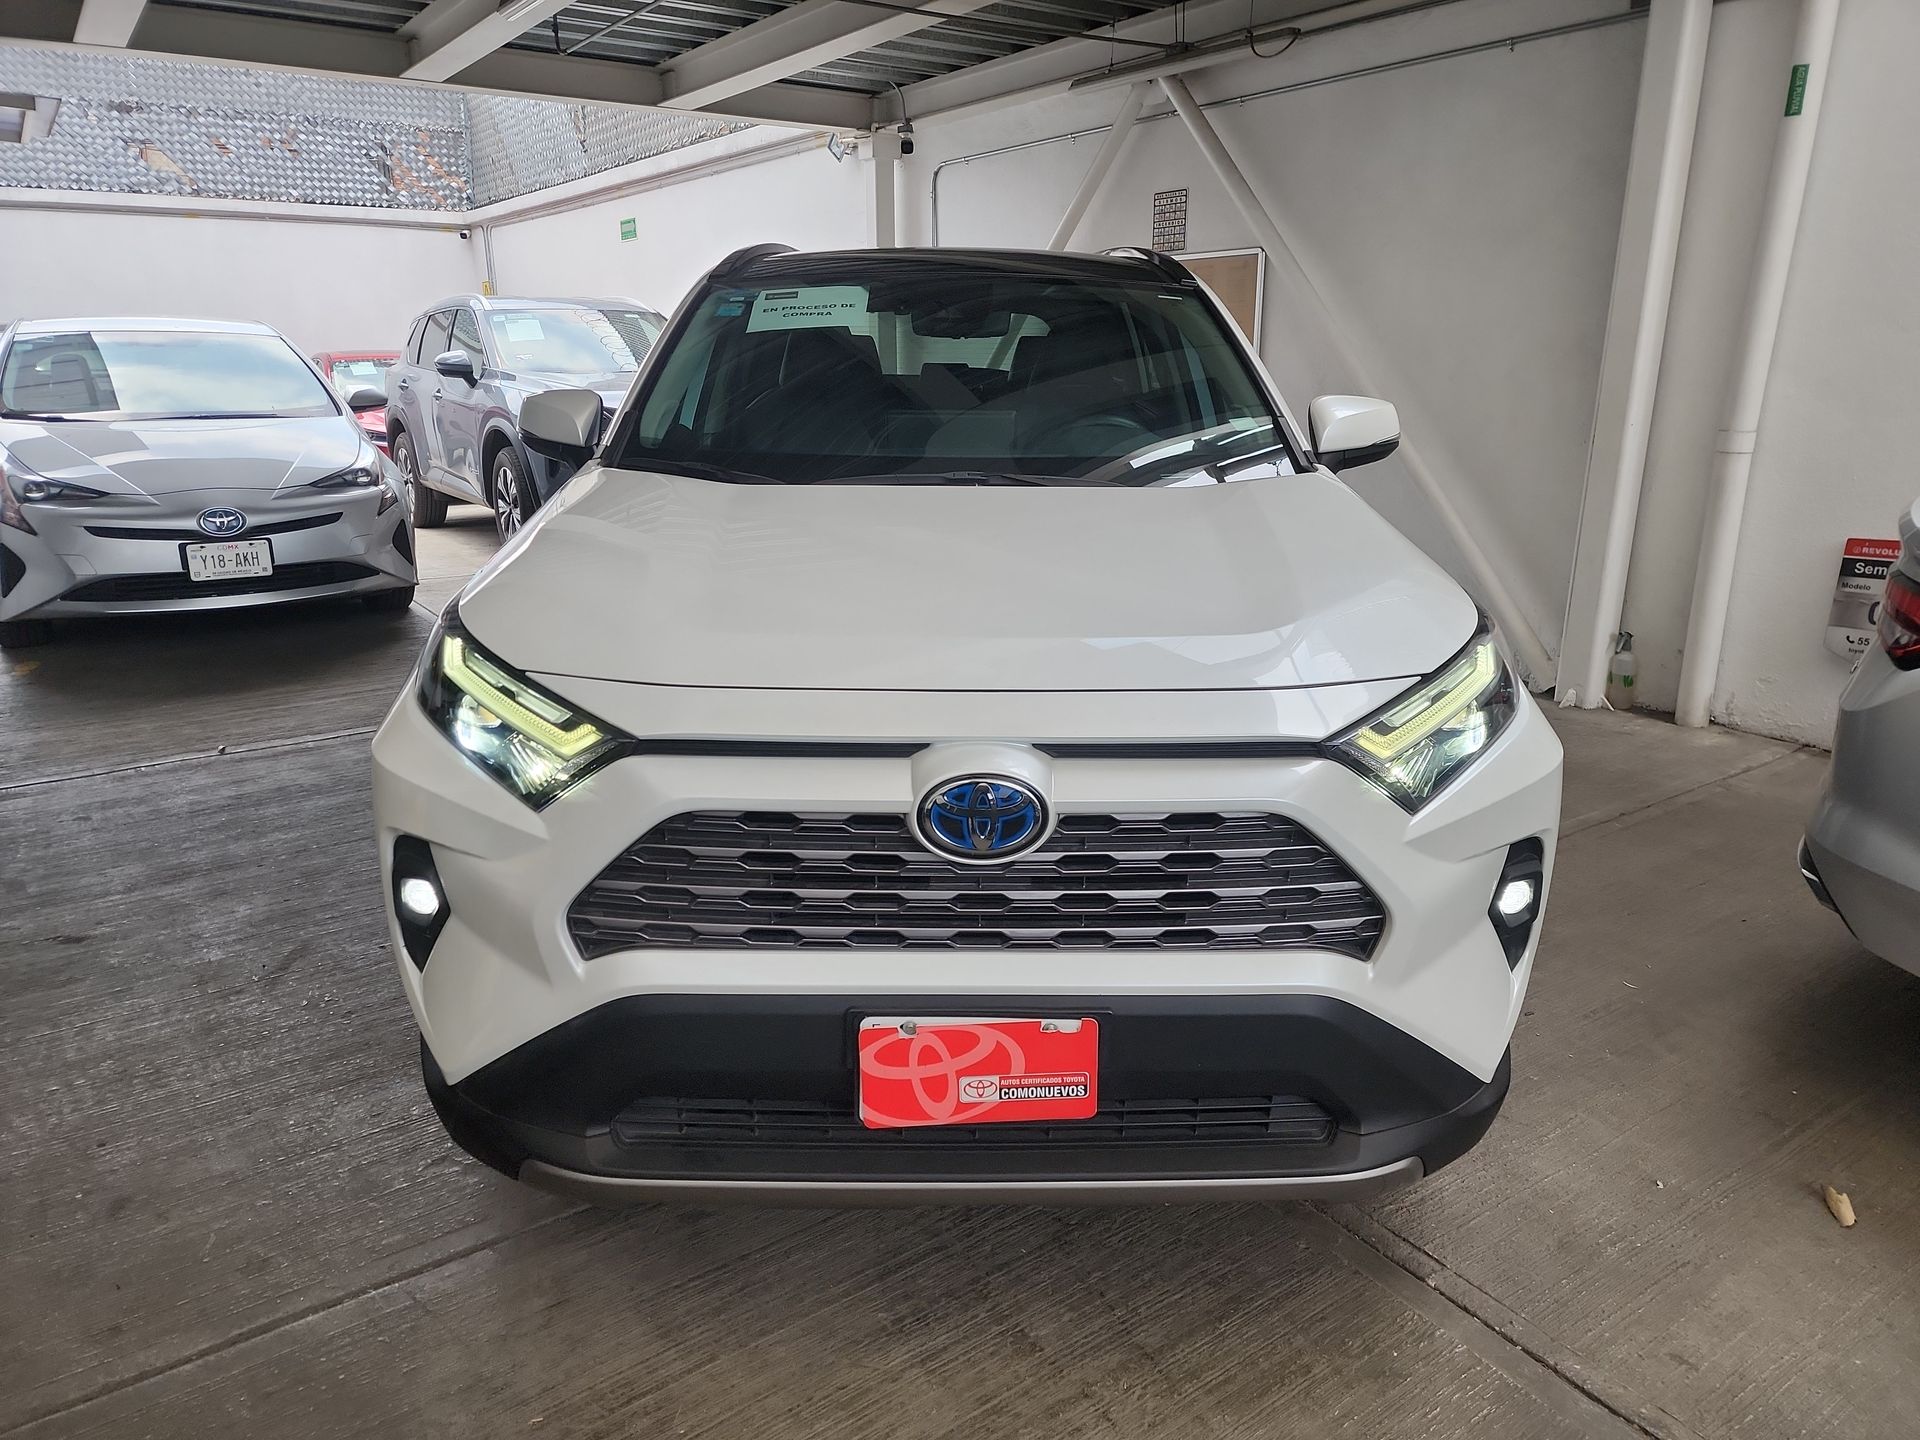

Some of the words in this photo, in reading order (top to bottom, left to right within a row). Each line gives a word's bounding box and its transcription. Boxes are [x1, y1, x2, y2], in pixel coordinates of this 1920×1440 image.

[781, 303, 837, 311] PROCESO
[200, 551, 260, 570] Y18-AKH
[1854, 562, 1888, 576] Sem
[1841, 581, 1871, 591] Modelo
[1857, 637, 1870, 646] 55
[1021, 1077, 1062, 1085] CERTIFICADOS
[1001, 1085, 1085, 1099] COMONUEVOS
